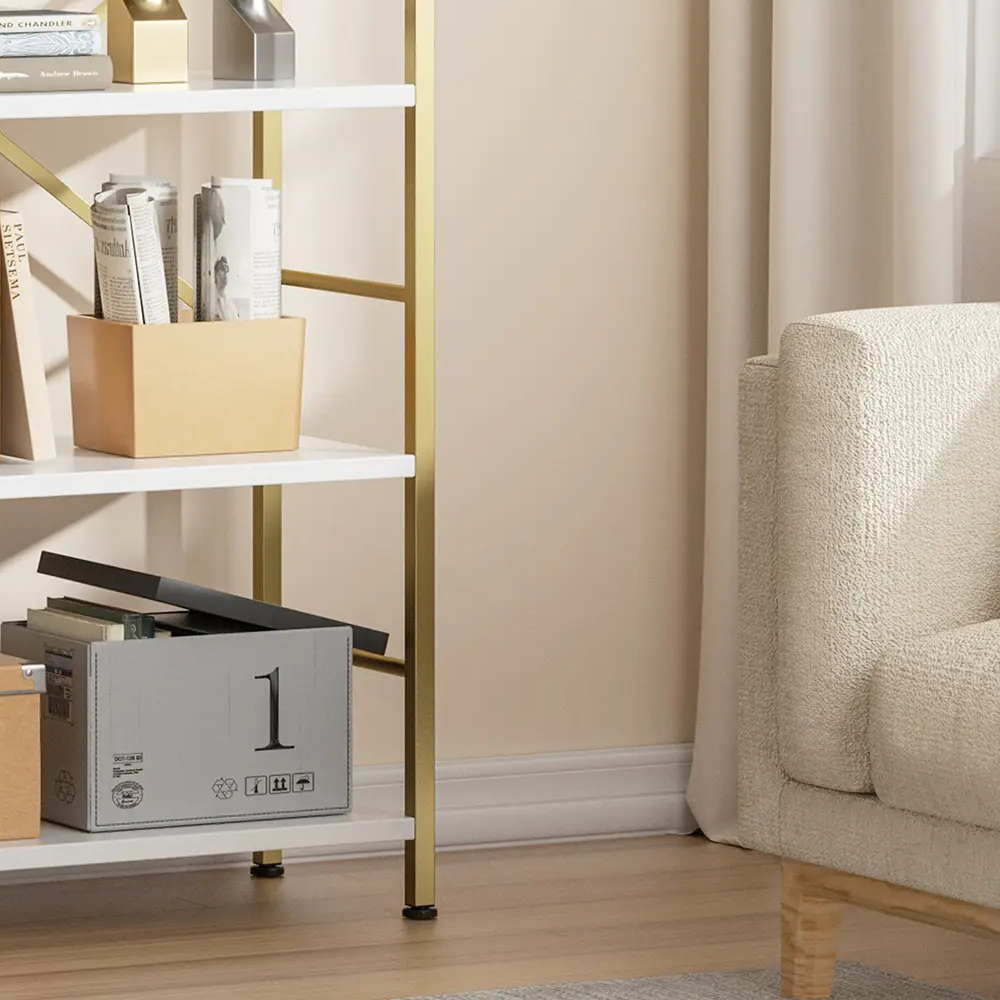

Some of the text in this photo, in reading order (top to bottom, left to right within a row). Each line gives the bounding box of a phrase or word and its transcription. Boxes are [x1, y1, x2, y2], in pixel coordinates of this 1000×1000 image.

[18, 20, 73, 28] CHANDLER
[40, 70, 71, 78] Andrew
[2, 224, 20, 300] SIETSEMA
[13, 223, 26, 263] PAUL
[254, 666, 295, 751] 1
